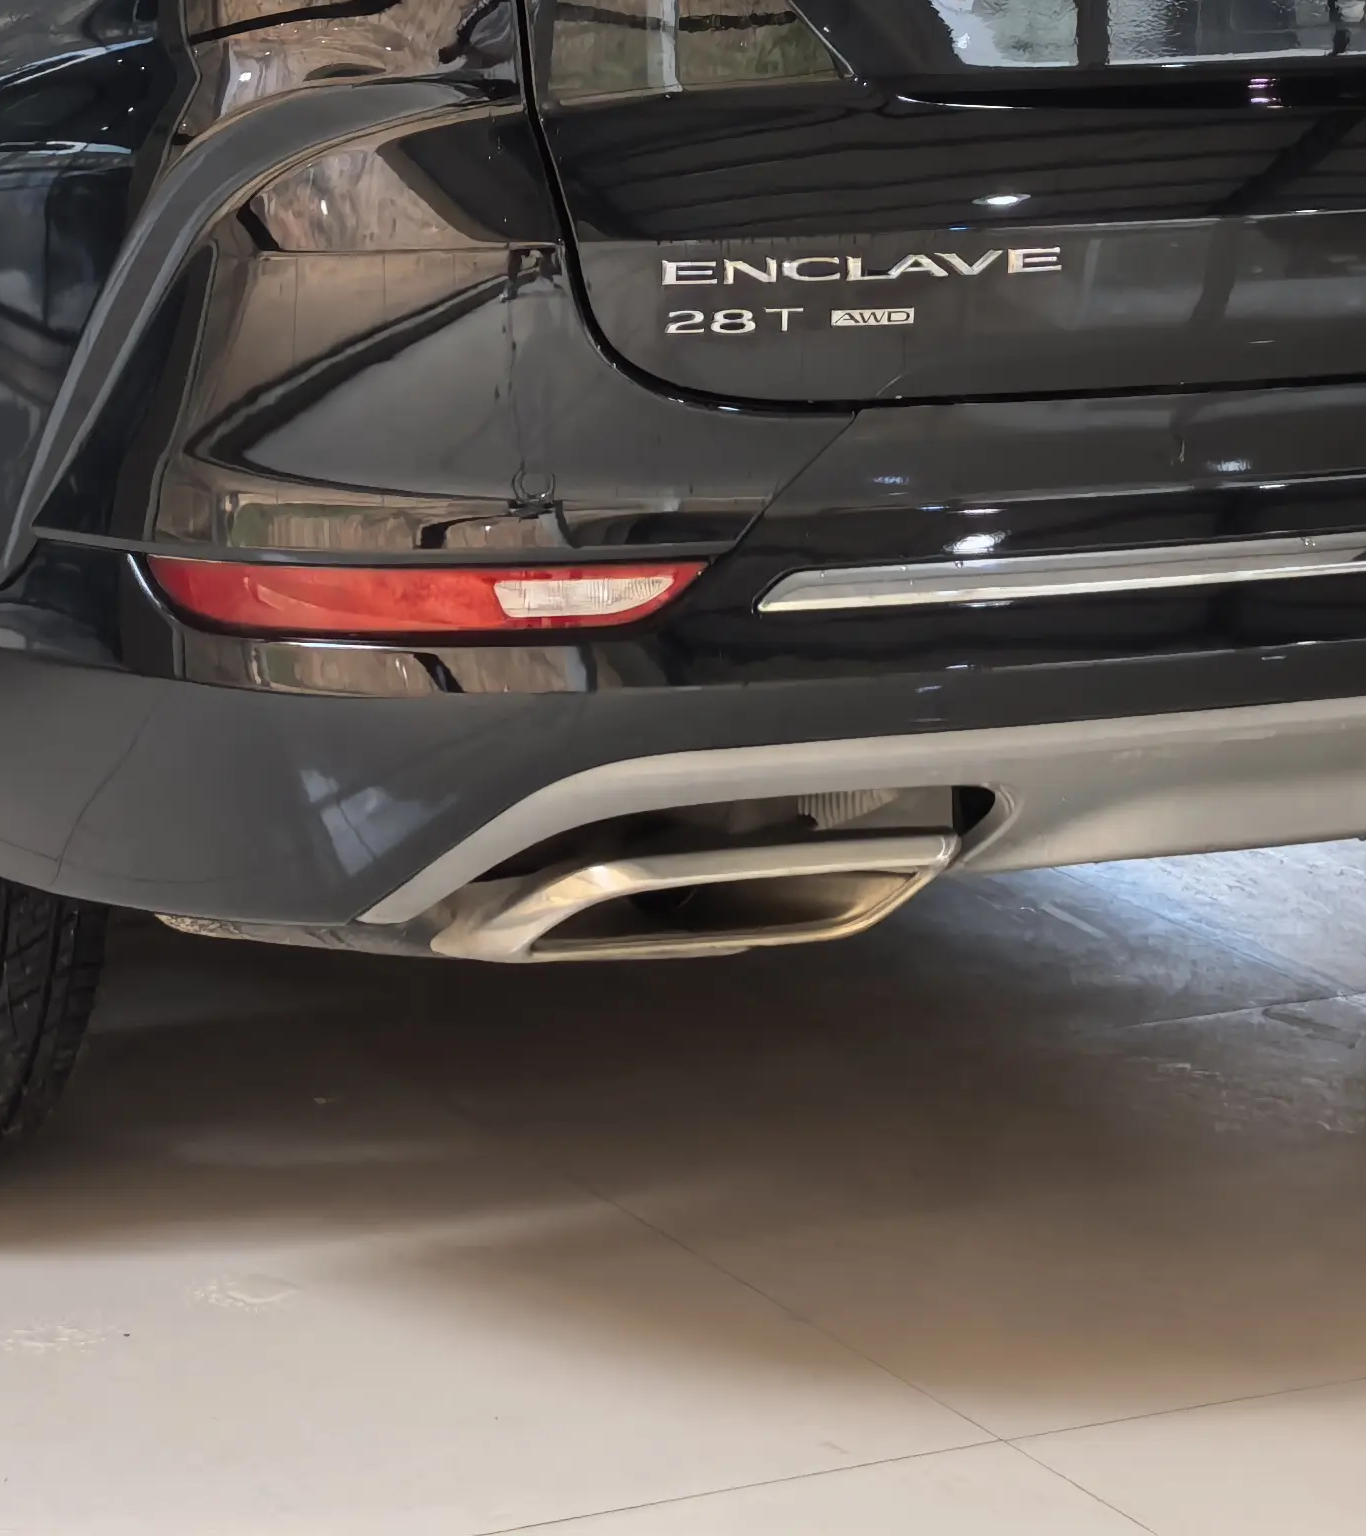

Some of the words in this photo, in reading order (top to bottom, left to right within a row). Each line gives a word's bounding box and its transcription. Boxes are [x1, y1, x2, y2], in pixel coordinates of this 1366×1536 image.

[661, 246, 1063, 286] ENCLAVE
[665, 307, 804, 335] 28T
[833, 309, 912, 325] AWD
